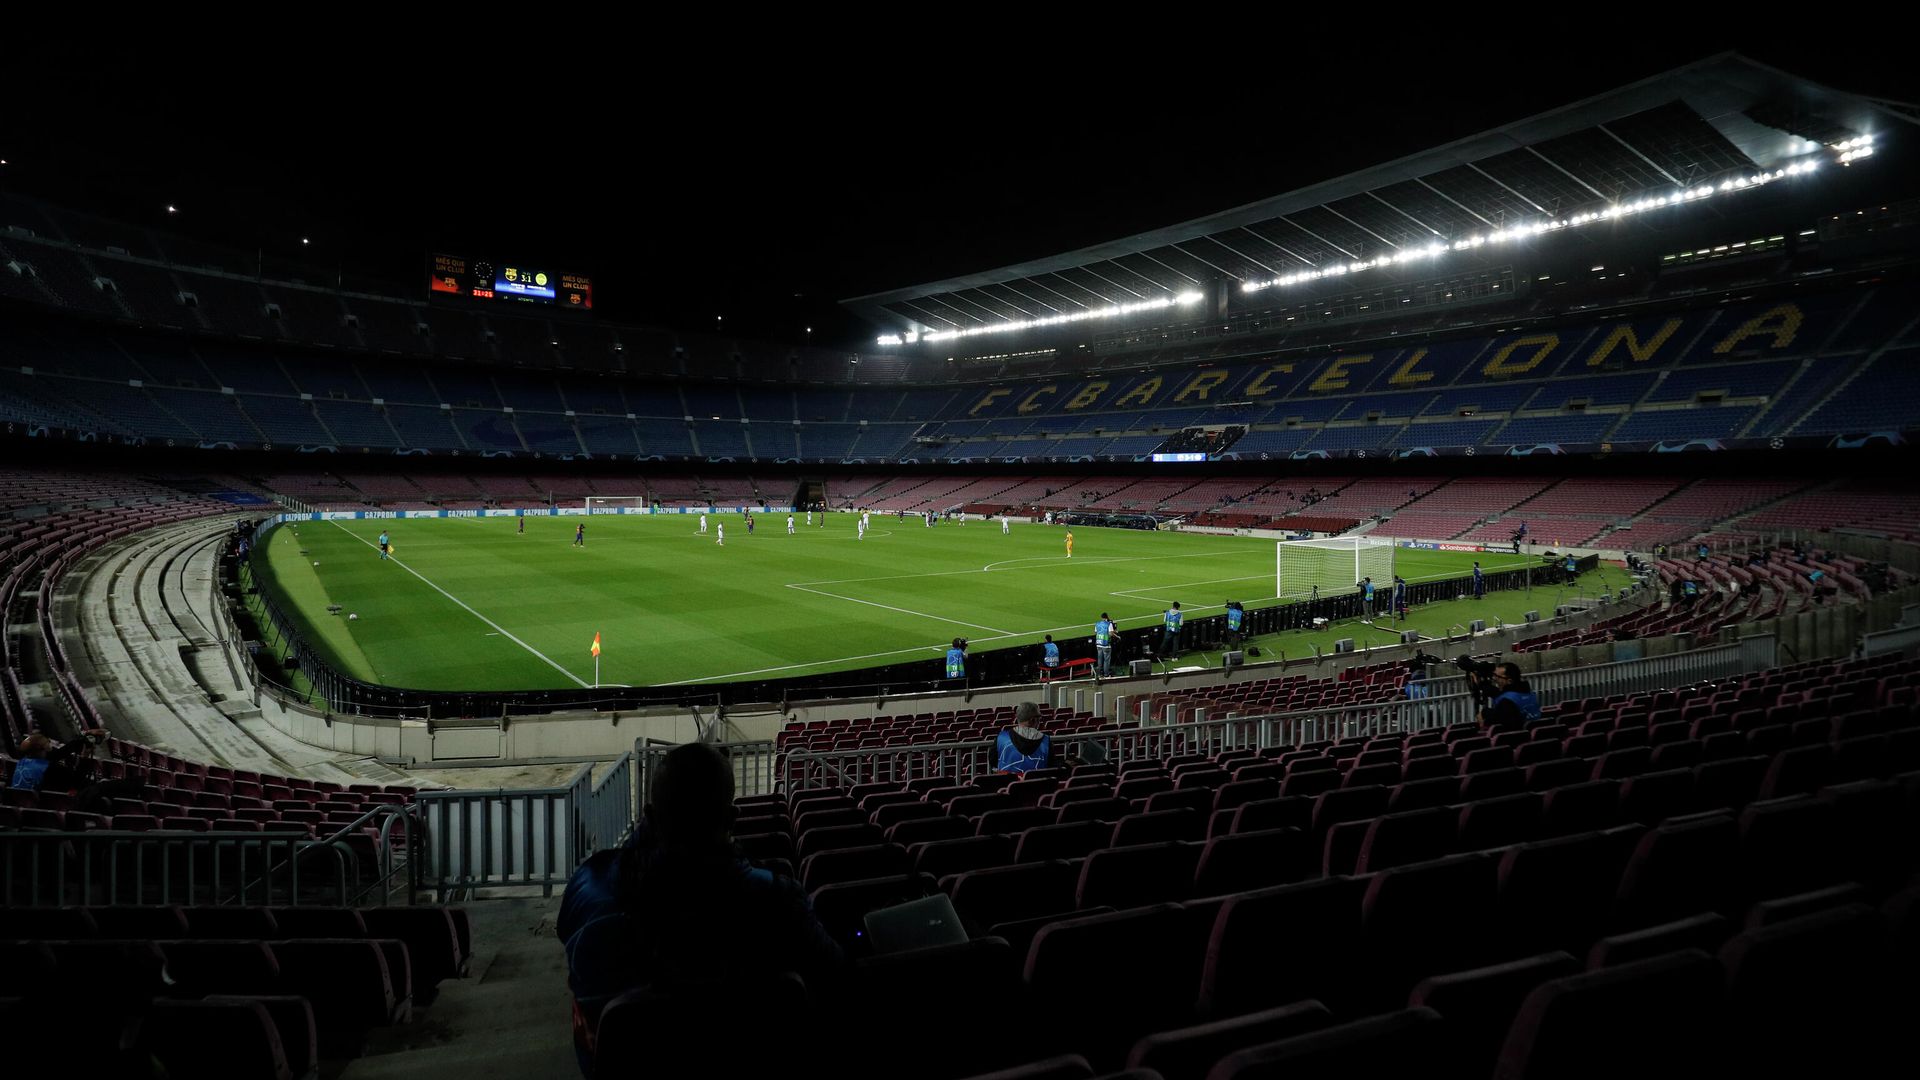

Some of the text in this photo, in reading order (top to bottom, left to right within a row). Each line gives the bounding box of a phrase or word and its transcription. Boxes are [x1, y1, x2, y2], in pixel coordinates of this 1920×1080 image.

[364, 511, 397, 519] GAZPROM
[447, 510, 477, 518] GAZPROM
[523, 508, 551, 516] GAZPROM
[592, 507, 618, 515] GAZPROM
[285, 512, 312, 521] GAZPROM
[1446, 544, 1477, 552] Santander
